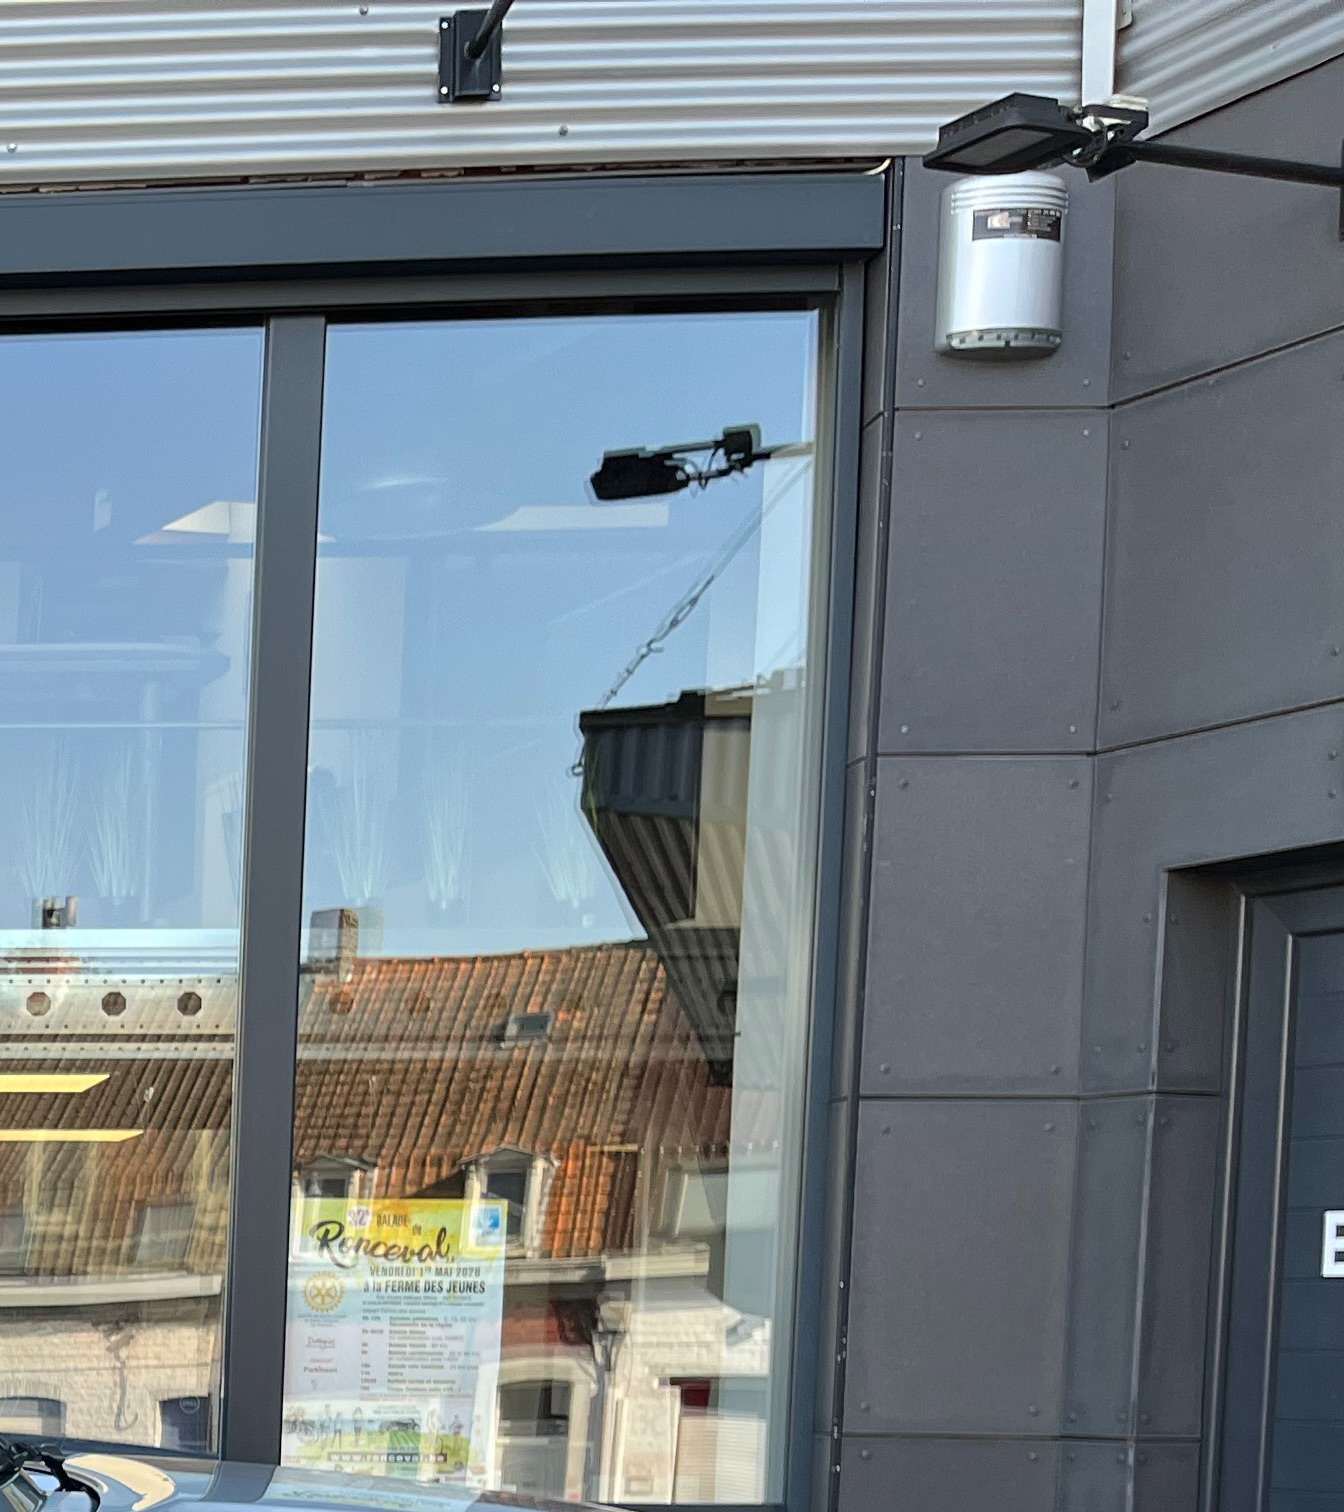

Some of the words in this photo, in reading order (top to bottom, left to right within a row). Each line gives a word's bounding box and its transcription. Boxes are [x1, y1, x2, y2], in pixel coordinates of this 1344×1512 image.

[435, 1266, 453, 1277] MAI
[385, 1280, 421, 1293] FERME
[424, 1281, 443, 1293] DES
[446, 1280, 486, 1294] JEUNES
